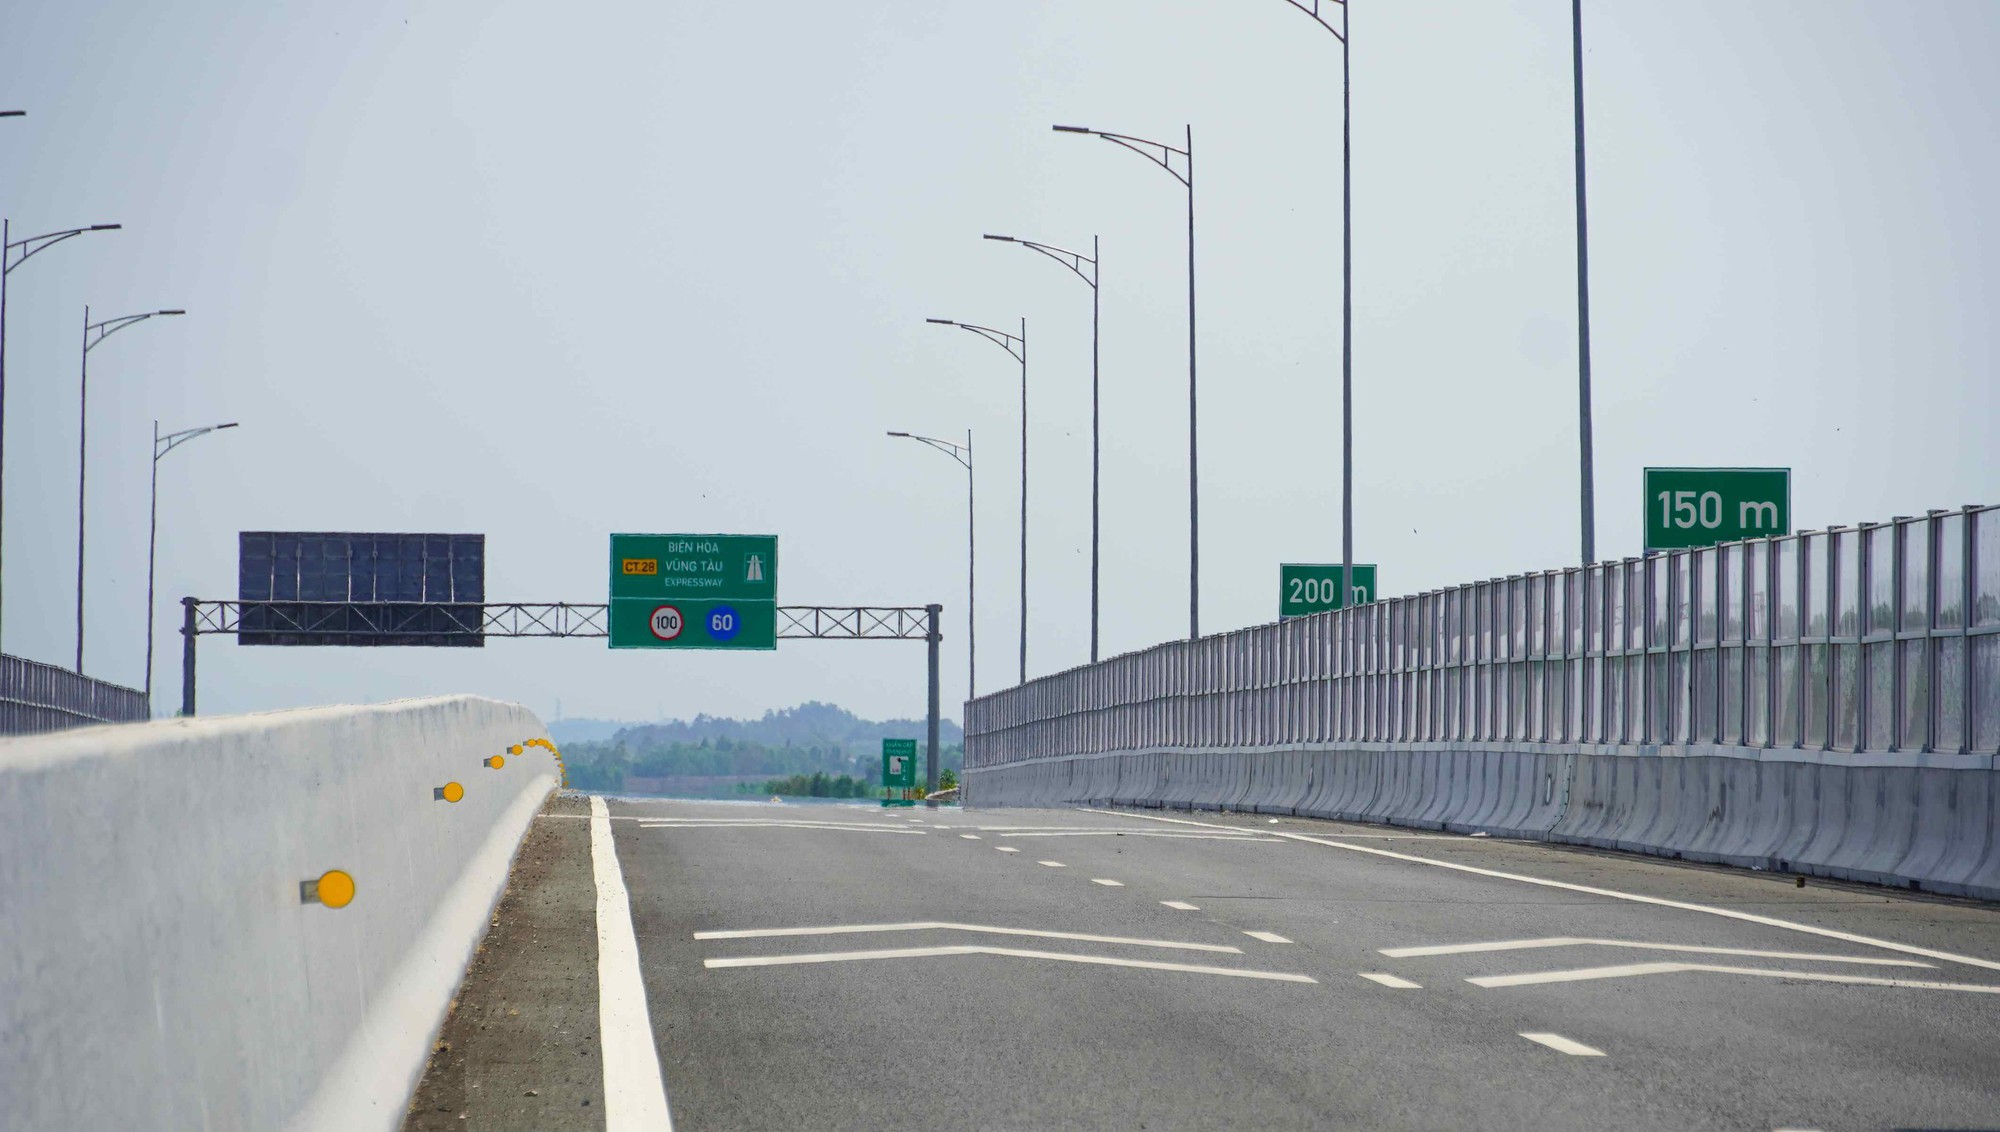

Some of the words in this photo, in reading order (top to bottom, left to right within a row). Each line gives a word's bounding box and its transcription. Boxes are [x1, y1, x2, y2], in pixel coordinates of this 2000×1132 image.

[1658, 490, 1723, 529] 150
[1739, 501, 1778, 529] m
[668, 540, 693, 553] BIÊN
[696, 540, 719, 553] HÒA
[625, 561, 655, 572] CT.28
[665, 558, 697, 572] VŨNG
[701, 558, 723, 572] TÀU
[665, 577, 723, 587] EXPRESSWAY
[1289, 578, 1334, 604] 200
[655, 615, 678, 629] 100
[712, 614, 733, 631] 60
